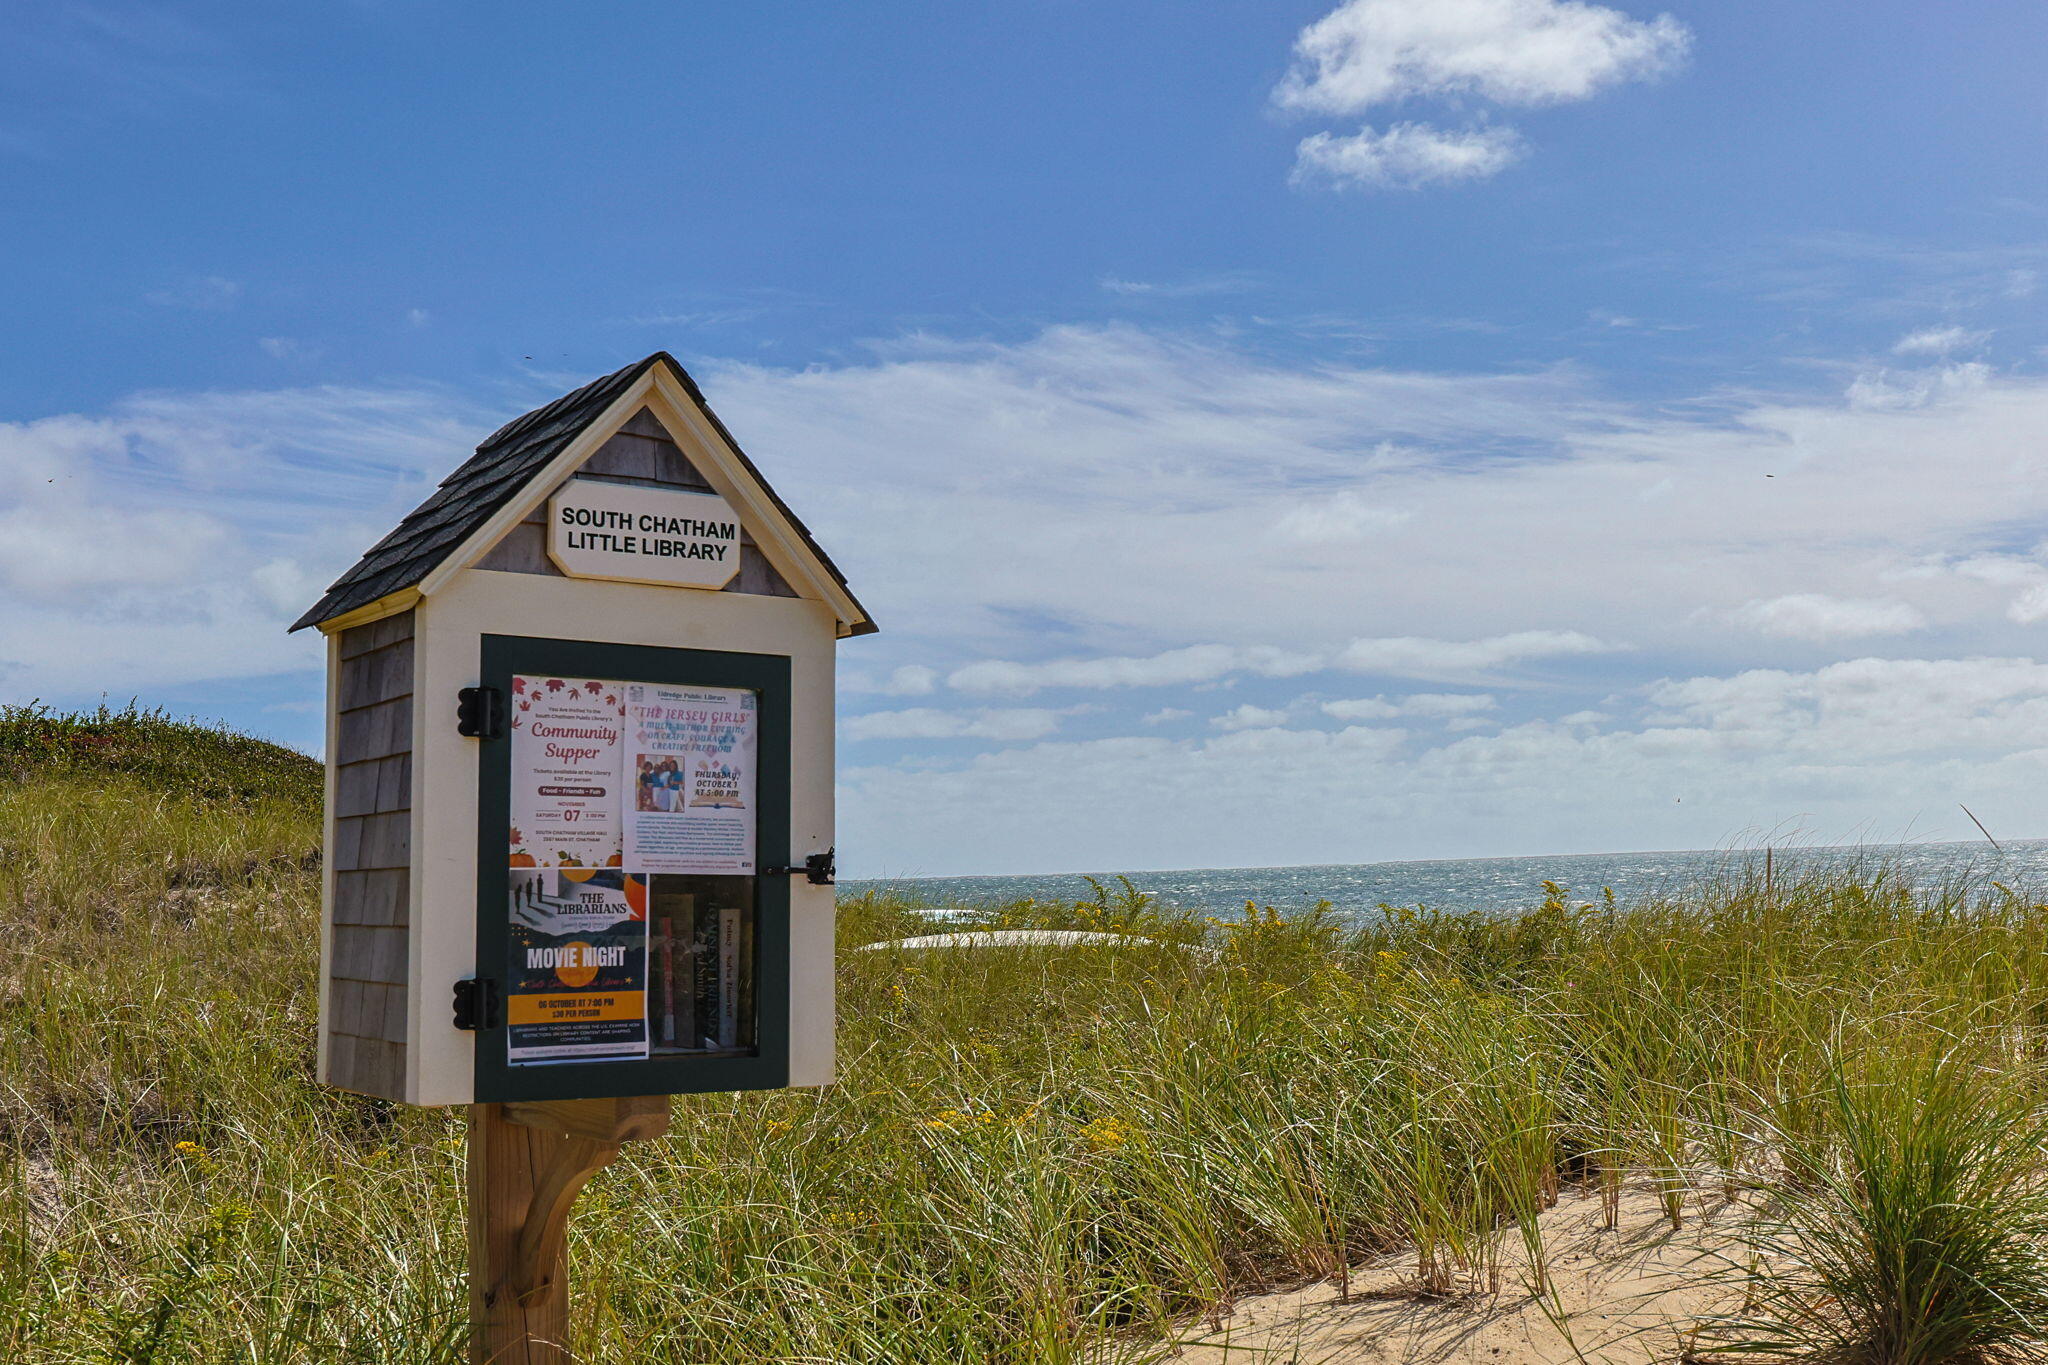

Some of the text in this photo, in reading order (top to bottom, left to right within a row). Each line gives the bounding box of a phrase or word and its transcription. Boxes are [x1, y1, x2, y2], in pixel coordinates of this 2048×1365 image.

[561, 506, 736, 541] SOUTH CHATHAM
[567, 531, 729, 562] LITTLE LIBRARY
[704, 693, 727, 701] Library
[666, 708, 707, 724] JERSEY
[532, 721, 619, 746] Community
[545, 743, 601, 765] Supper
[593, 770, 611, 778] Library
[695, 770, 740, 781] THURSDAY,
[696, 780, 731, 788] OCTOBER
[694, 788, 739, 798] AT 5:00 PM
[564, 809, 581, 821] 07
[579, 892, 605, 904] THE
[557, 903, 627, 915] LIBRARIANS
[527, 946, 626, 969] MOVIE NIGHT
[549, 999, 577, 1008] OCTOBER
[578, 998, 587, 1007] AT
[588, 998, 602, 1007] 7:00
[604, 997, 615, 1006] PM
[706, 977, 719, 1034] FRIENDS
[565, 1009, 577, 1018] PER
[578, 1008, 601, 1018] PERSON
